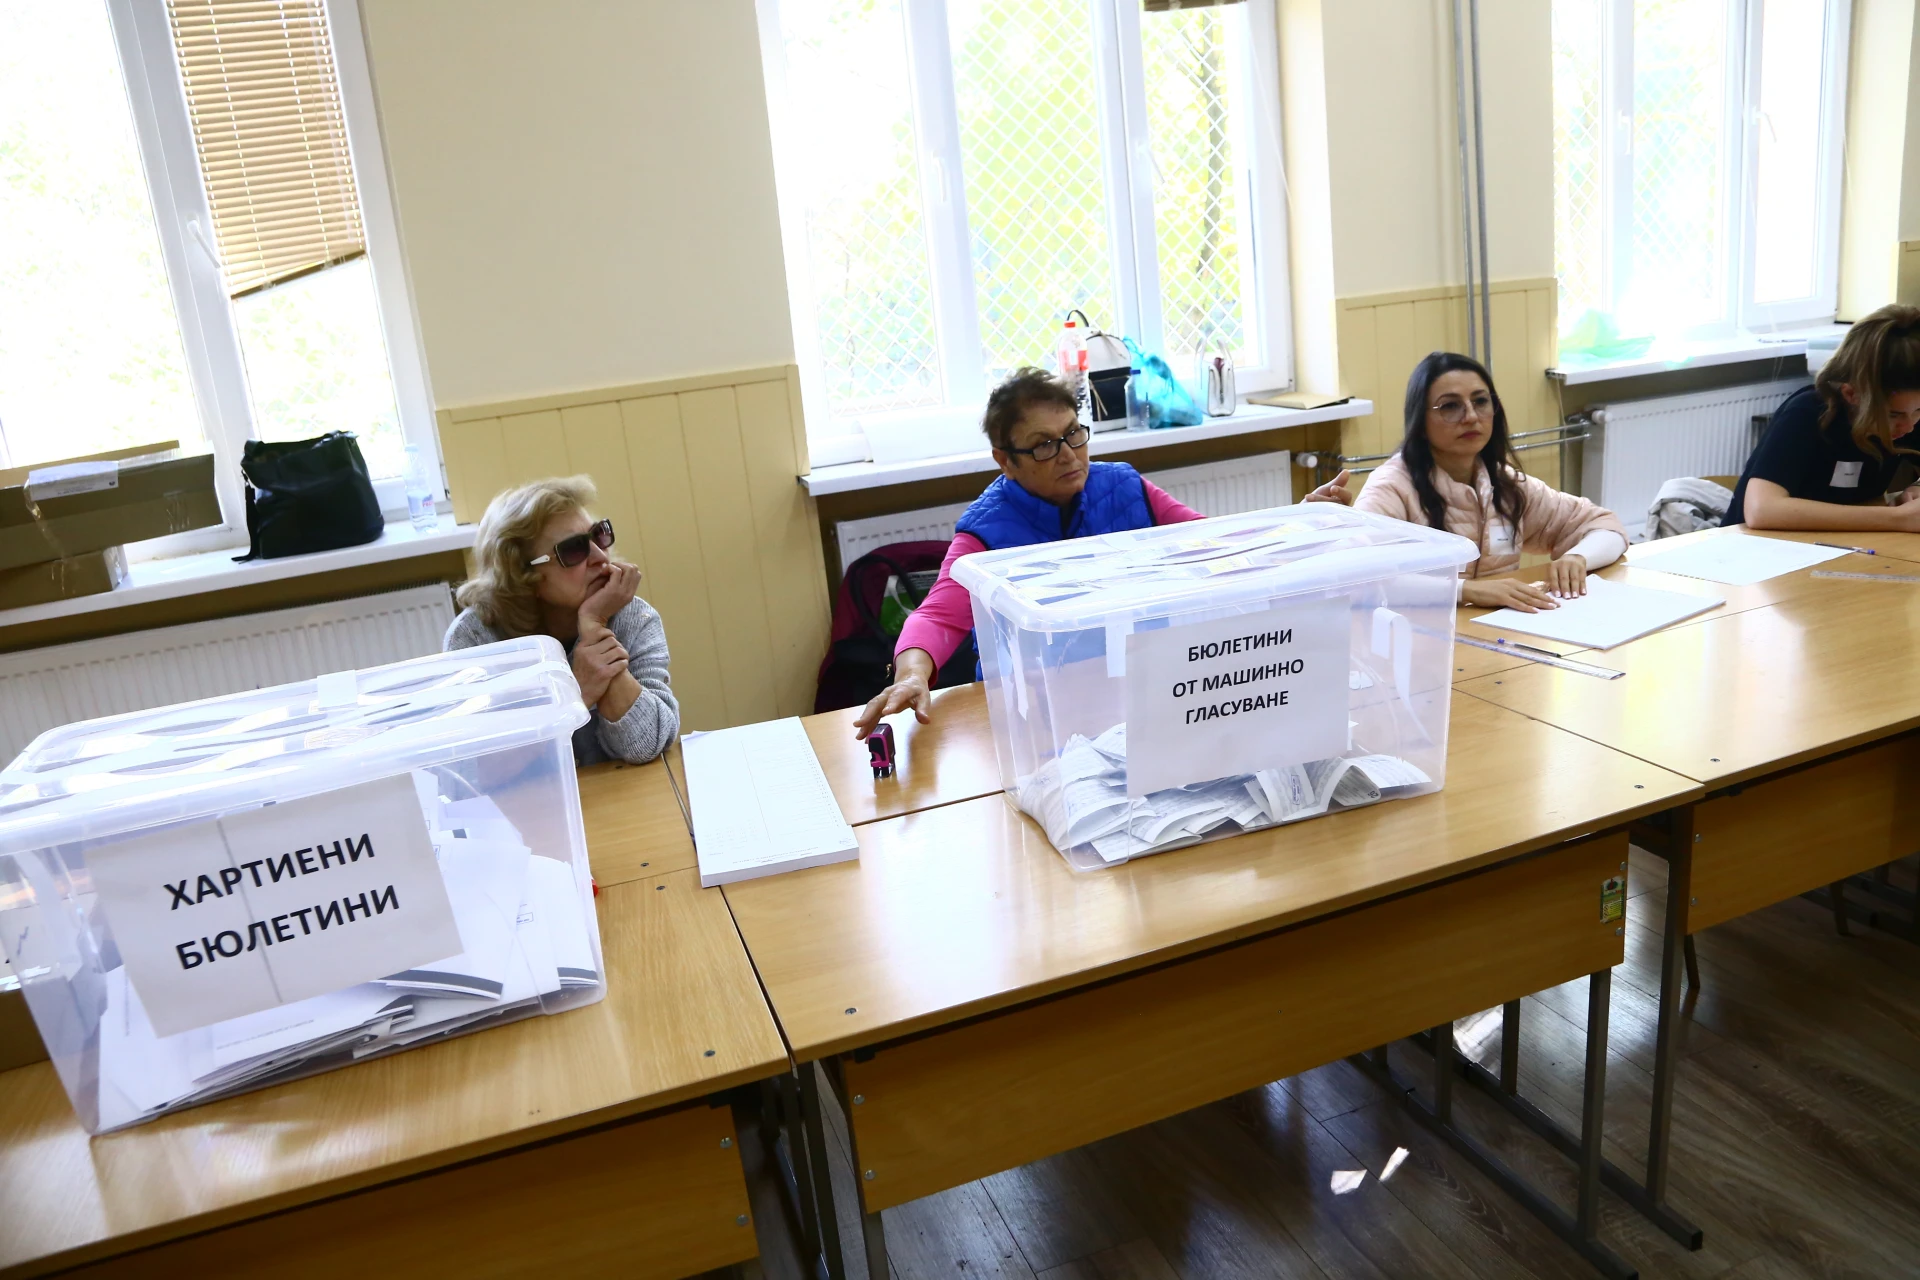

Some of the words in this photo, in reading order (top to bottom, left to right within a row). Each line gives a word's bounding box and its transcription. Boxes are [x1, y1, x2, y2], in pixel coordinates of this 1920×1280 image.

[1188, 628, 1292, 662] БЮЛЕТИНИ
[1172, 679, 1198, 698] ОТ
[1202, 658, 1304, 692] МАШИННО
[1185, 690, 1289, 725] ГЛАСУВАНЕ
[163, 833, 375, 911] ХАРТИЕНИ
[175, 885, 400, 970] БЮЛЕТИНИ
